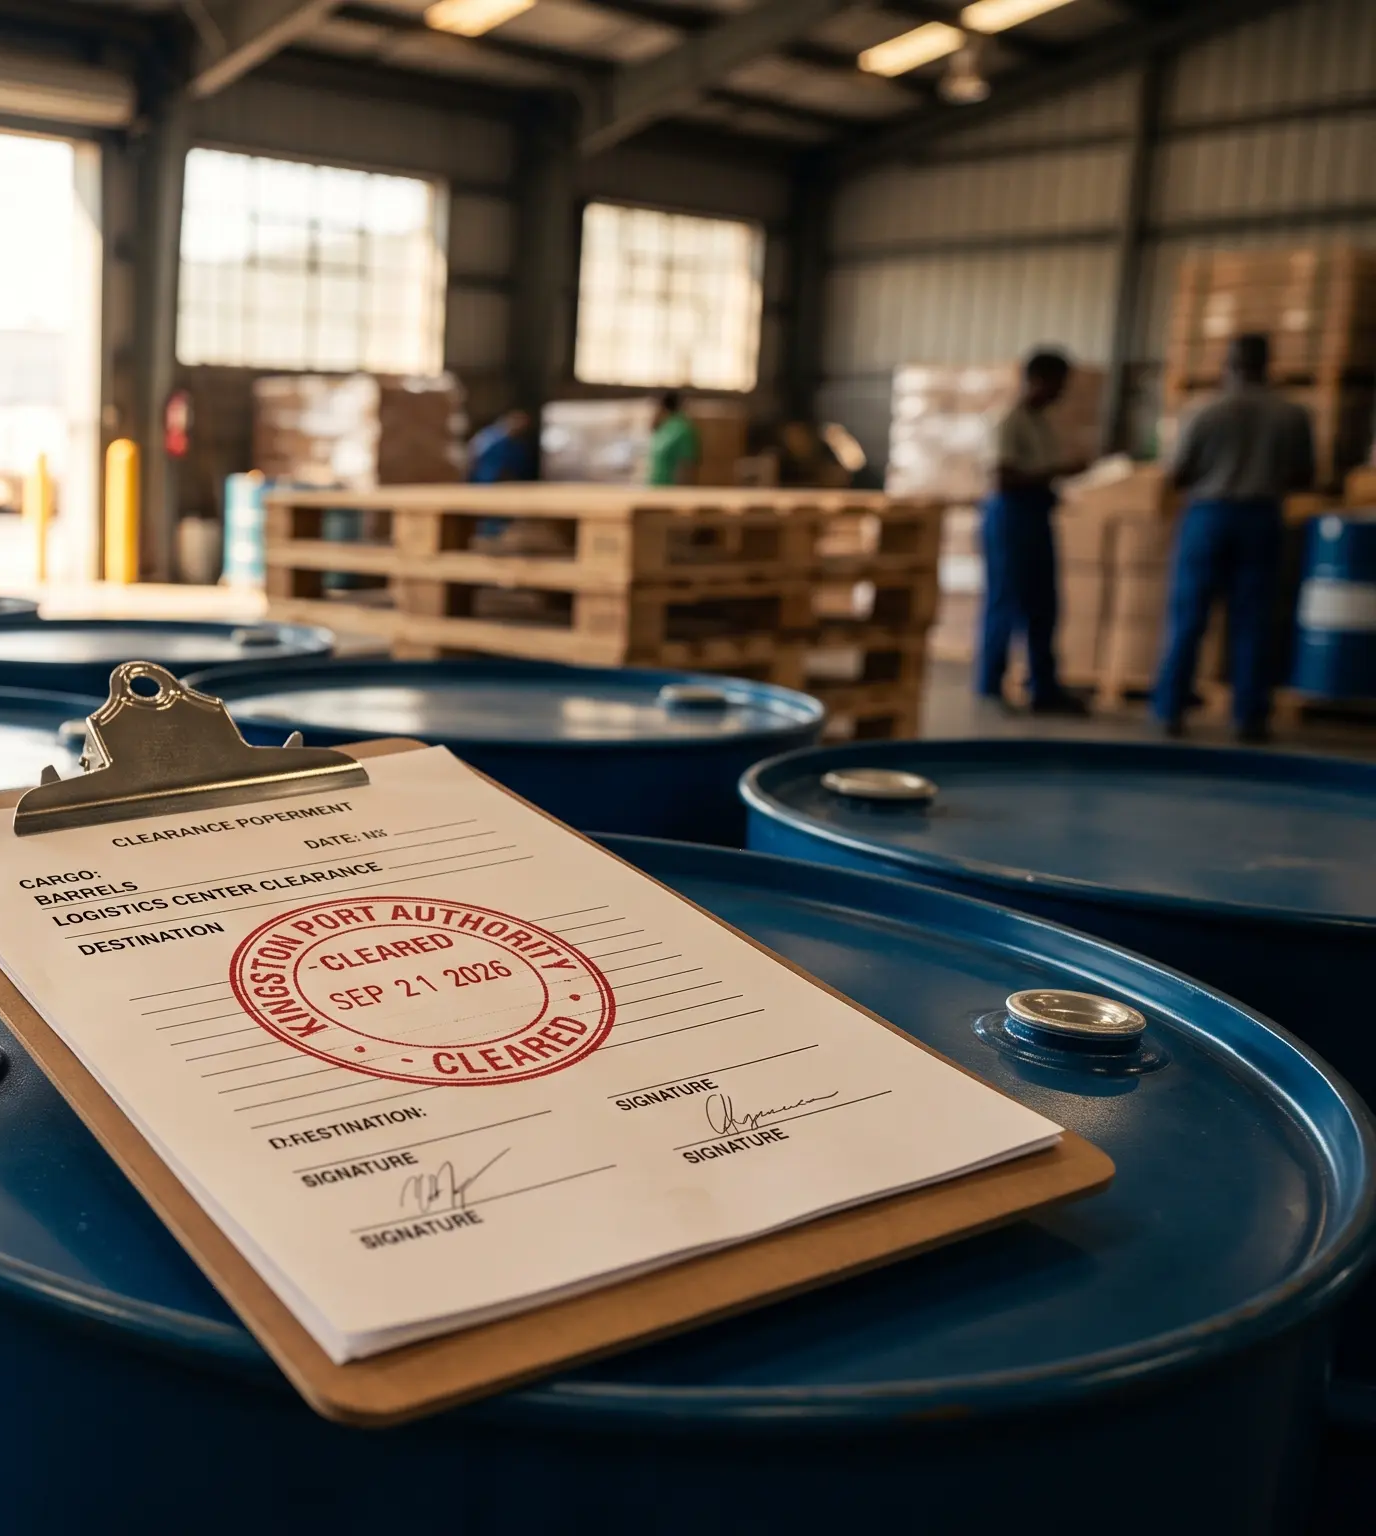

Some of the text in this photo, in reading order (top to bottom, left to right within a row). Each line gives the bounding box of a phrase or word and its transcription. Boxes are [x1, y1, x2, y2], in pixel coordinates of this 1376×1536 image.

[112, 802, 354, 848] CLEARANCE POPERMENT
[304, 833, 361, 849] DATE:
[19, 870, 101, 889] CARGO:
[34, 881, 138, 906] BARRELS
[52, 861, 383, 927] LOGISTICS CENTER CLEARANCE
[77, 921, 224, 956] DESTINATION
[250, 904, 577, 1038] KINGSTON PORT AUTHORITY
[329, 959, 512, 1010] SEP 21 2026
[615, 1078, 719, 1111] SIGNATURE
[683, 1128, 789, 1164] SIGNATURE
[301, 1151, 419, 1188] SIGNATURE
[360, 1209, 484, 1250] SIGNATURE
